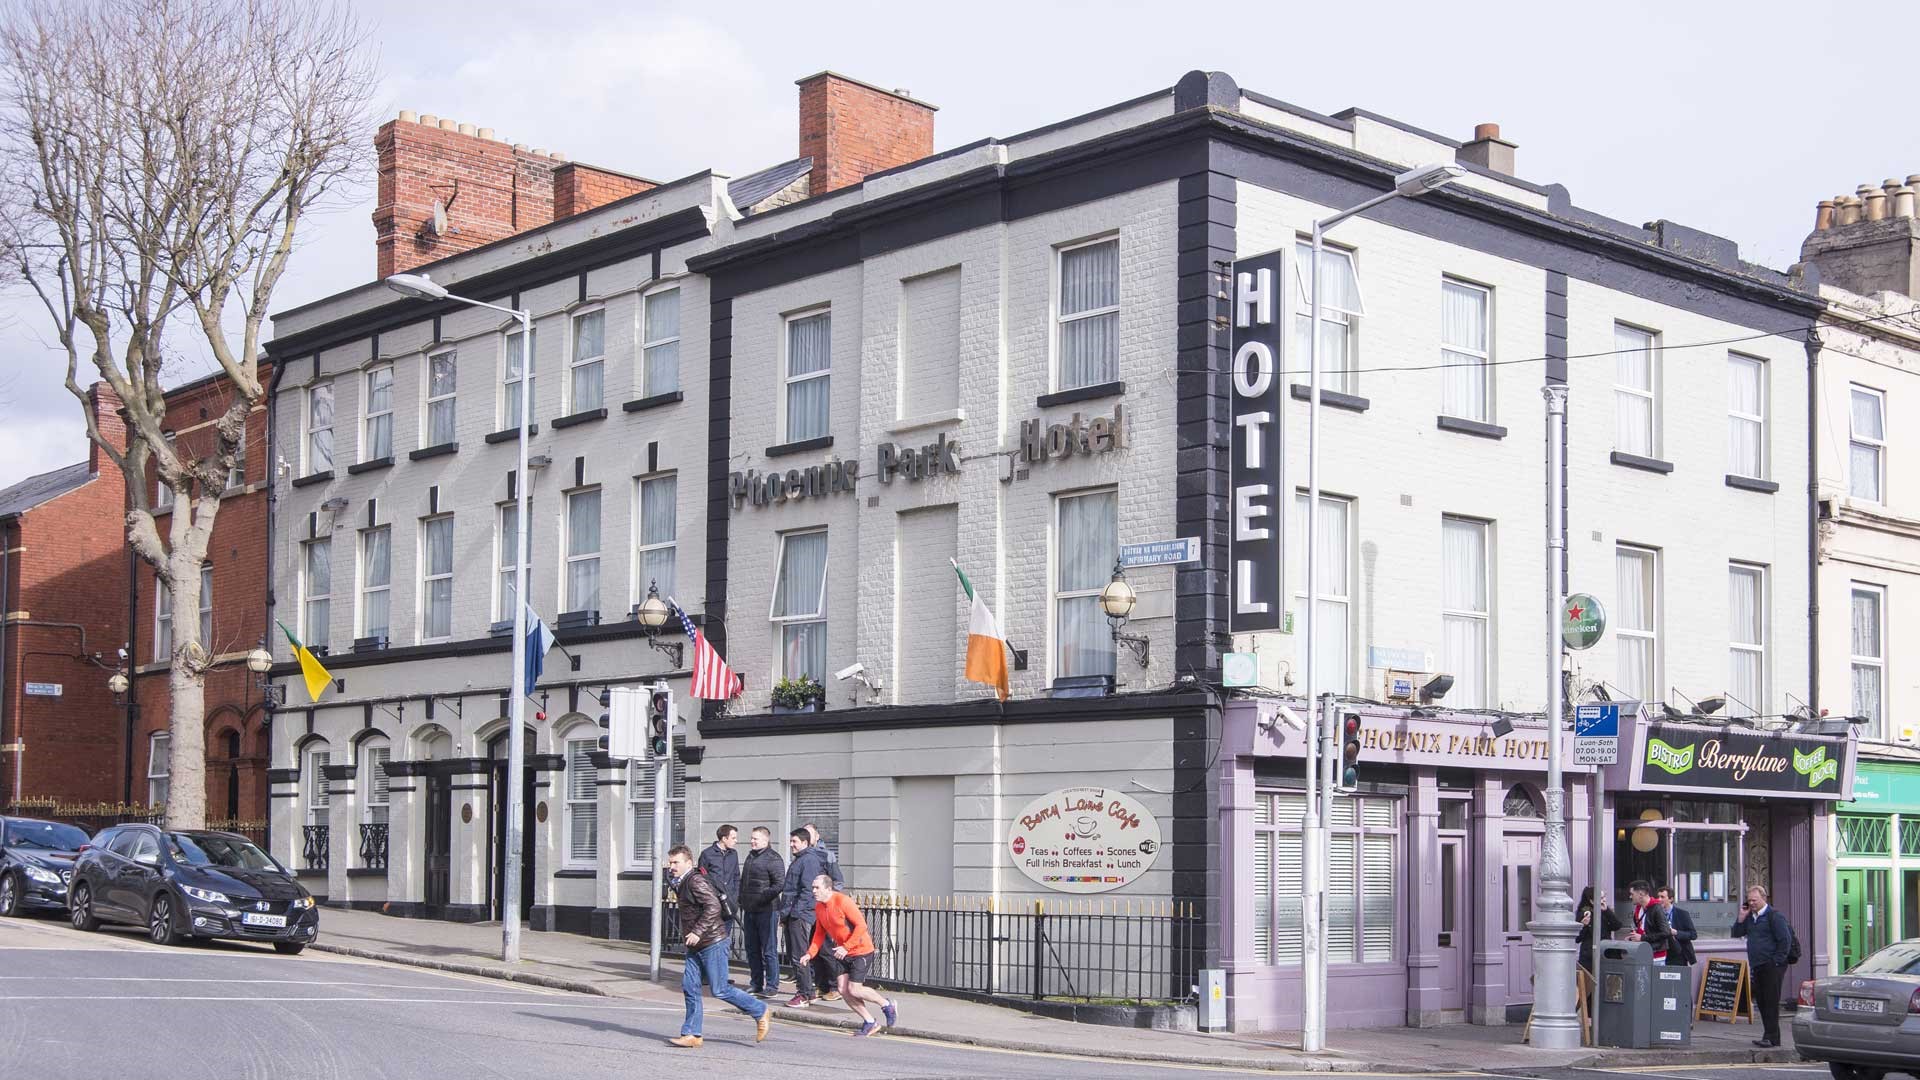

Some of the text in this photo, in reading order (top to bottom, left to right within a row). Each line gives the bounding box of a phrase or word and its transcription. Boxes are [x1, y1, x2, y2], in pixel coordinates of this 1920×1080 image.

[1234, 267, 1272, 614] HOTEL
[729, 402, 1129, 509] Phoenix Park Hotel
[1128, 552, 1182, 564] INFIRMARY ROAD
[1359, 728, 1441, 753] HOENIX
[1447, 735, 1497, 757] PARK
[1651, 743, 1691, 769] BISTRO
[1698, 740, 1788, 781] Berrylane
[1796, 749, 1824, 770] COFFEE
[1812, 762, 1835, 784] DOCK
[1019, 804, 1061, 831] Berry
[1065, 797, 1104, 812] Lane
[1026, 859, 1141, 868] Full Irish Breakfast Lunch
[1030, 847, 1136, 856] Teas Coffees Scones
